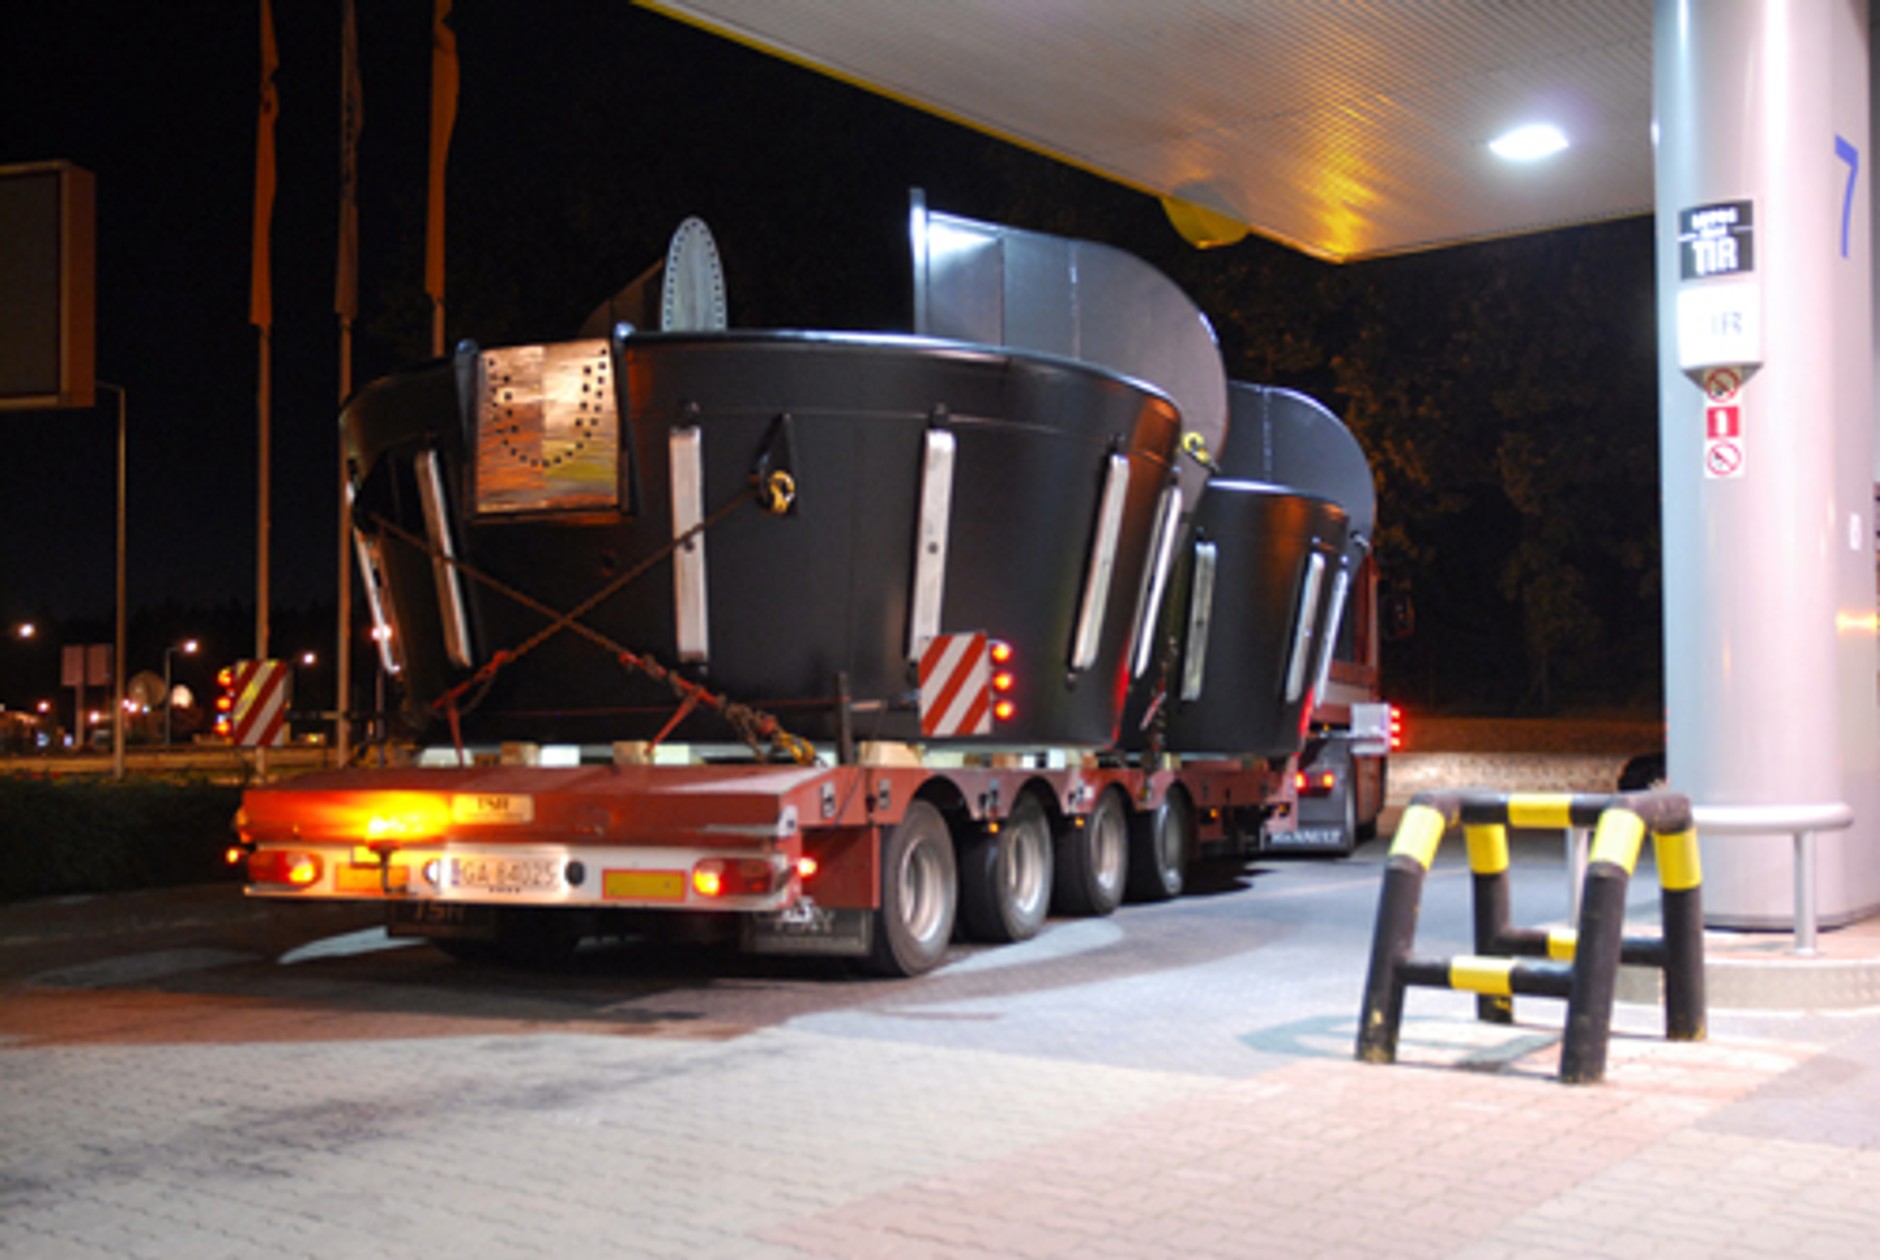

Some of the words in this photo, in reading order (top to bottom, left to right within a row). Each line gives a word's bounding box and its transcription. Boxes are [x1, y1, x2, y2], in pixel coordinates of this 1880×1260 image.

[1834, 133, 1858, 259] 7
[1692, 237, 1738, 275] TIR
[462, 860, 489, 886] GA
